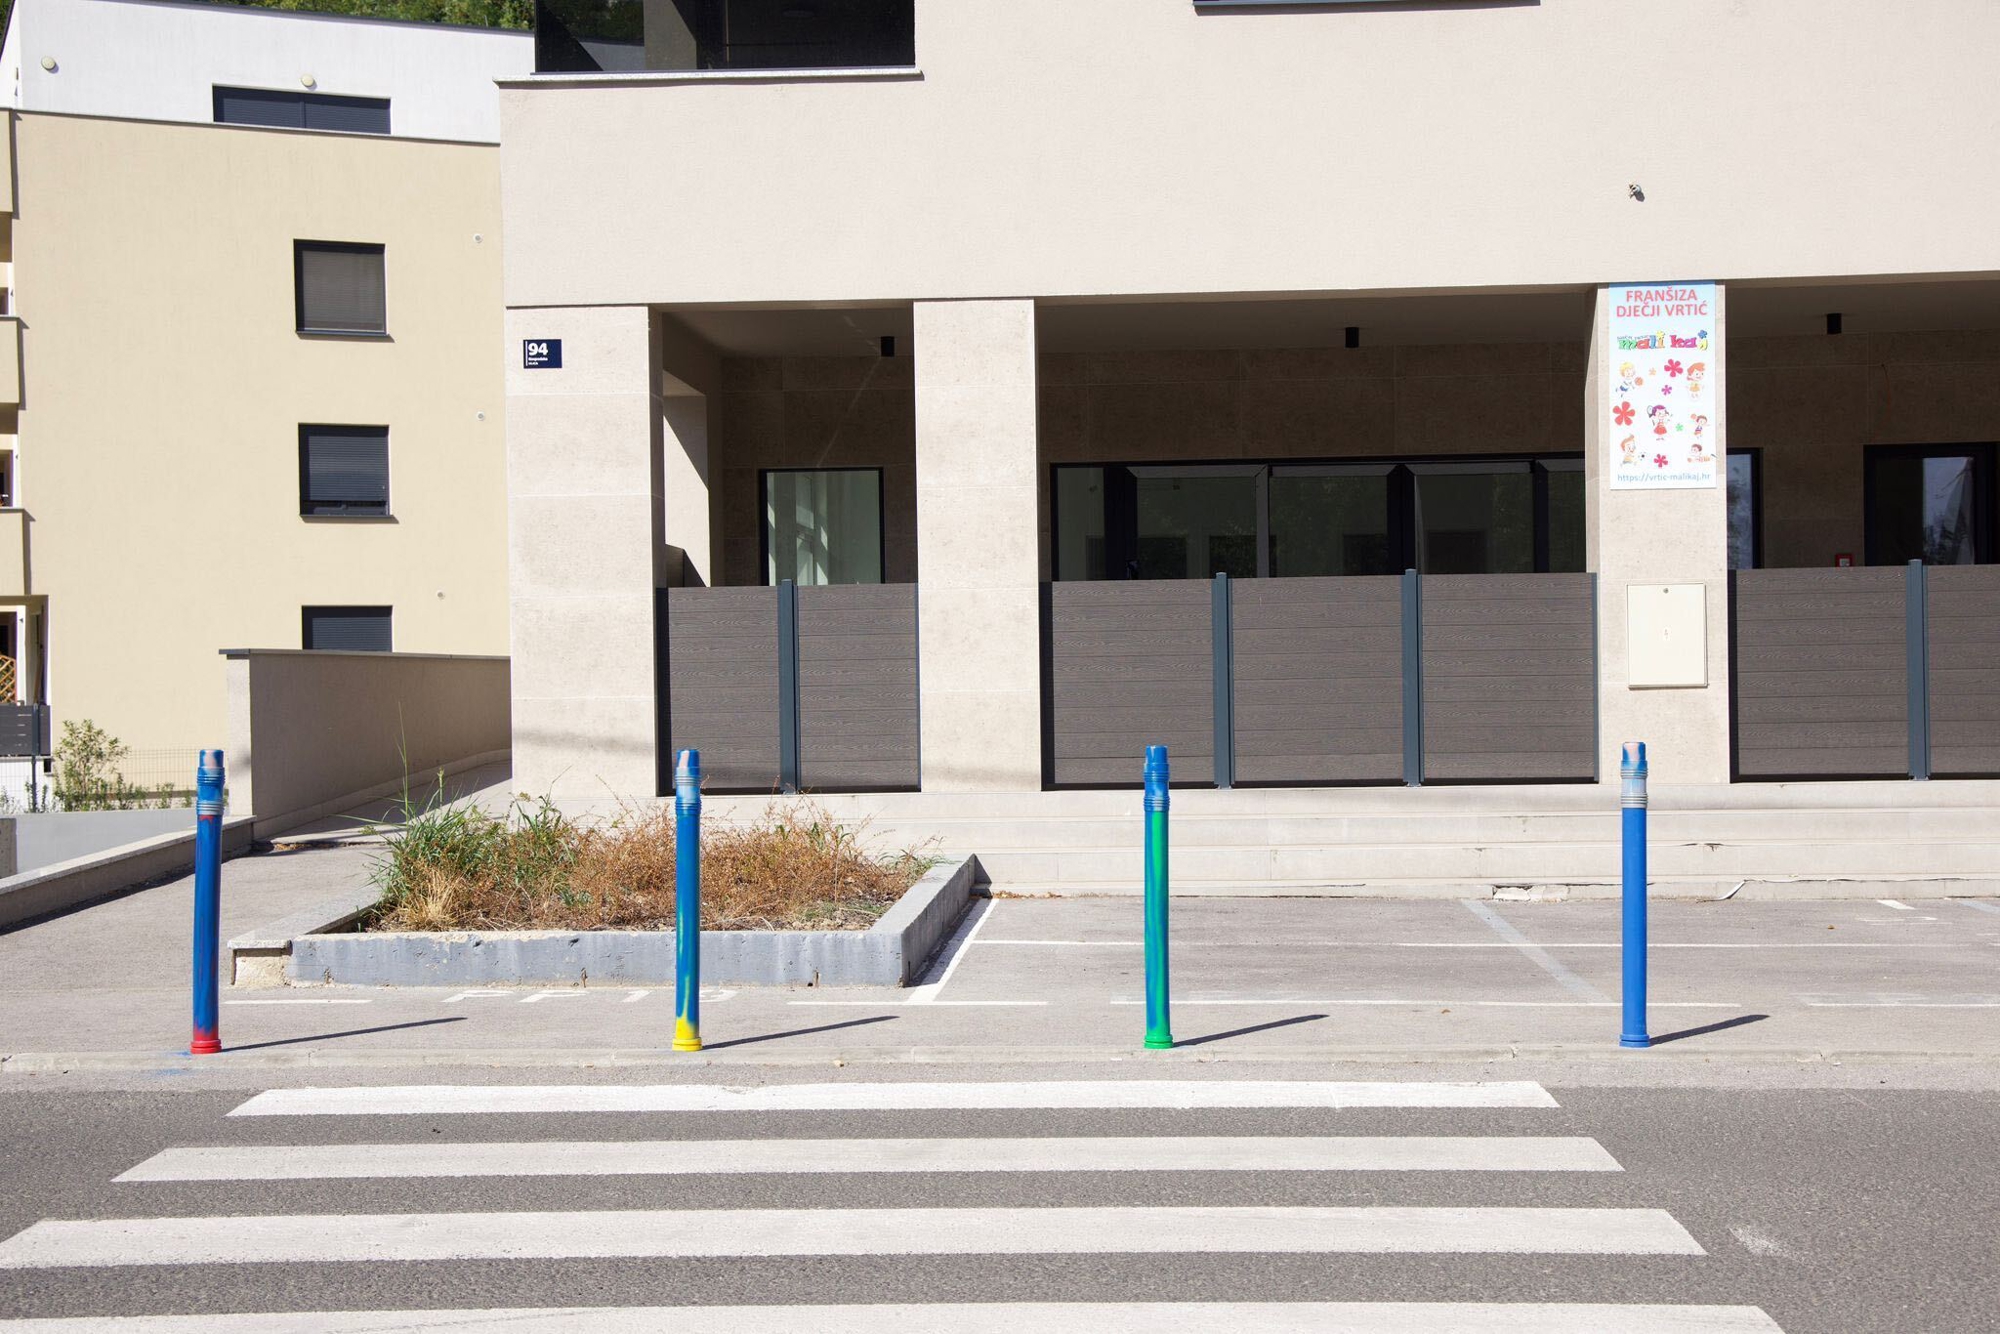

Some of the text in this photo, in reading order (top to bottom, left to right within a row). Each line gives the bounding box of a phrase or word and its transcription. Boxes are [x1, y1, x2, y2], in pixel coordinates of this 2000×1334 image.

[1626, 286, 1698, 302] FRANŠIZA
[1616, 300, 1708, 317] DJEČJI VRTIĆ
[1618, 330, 1665, 350] mali
[528, 342, 548, 356] 94
